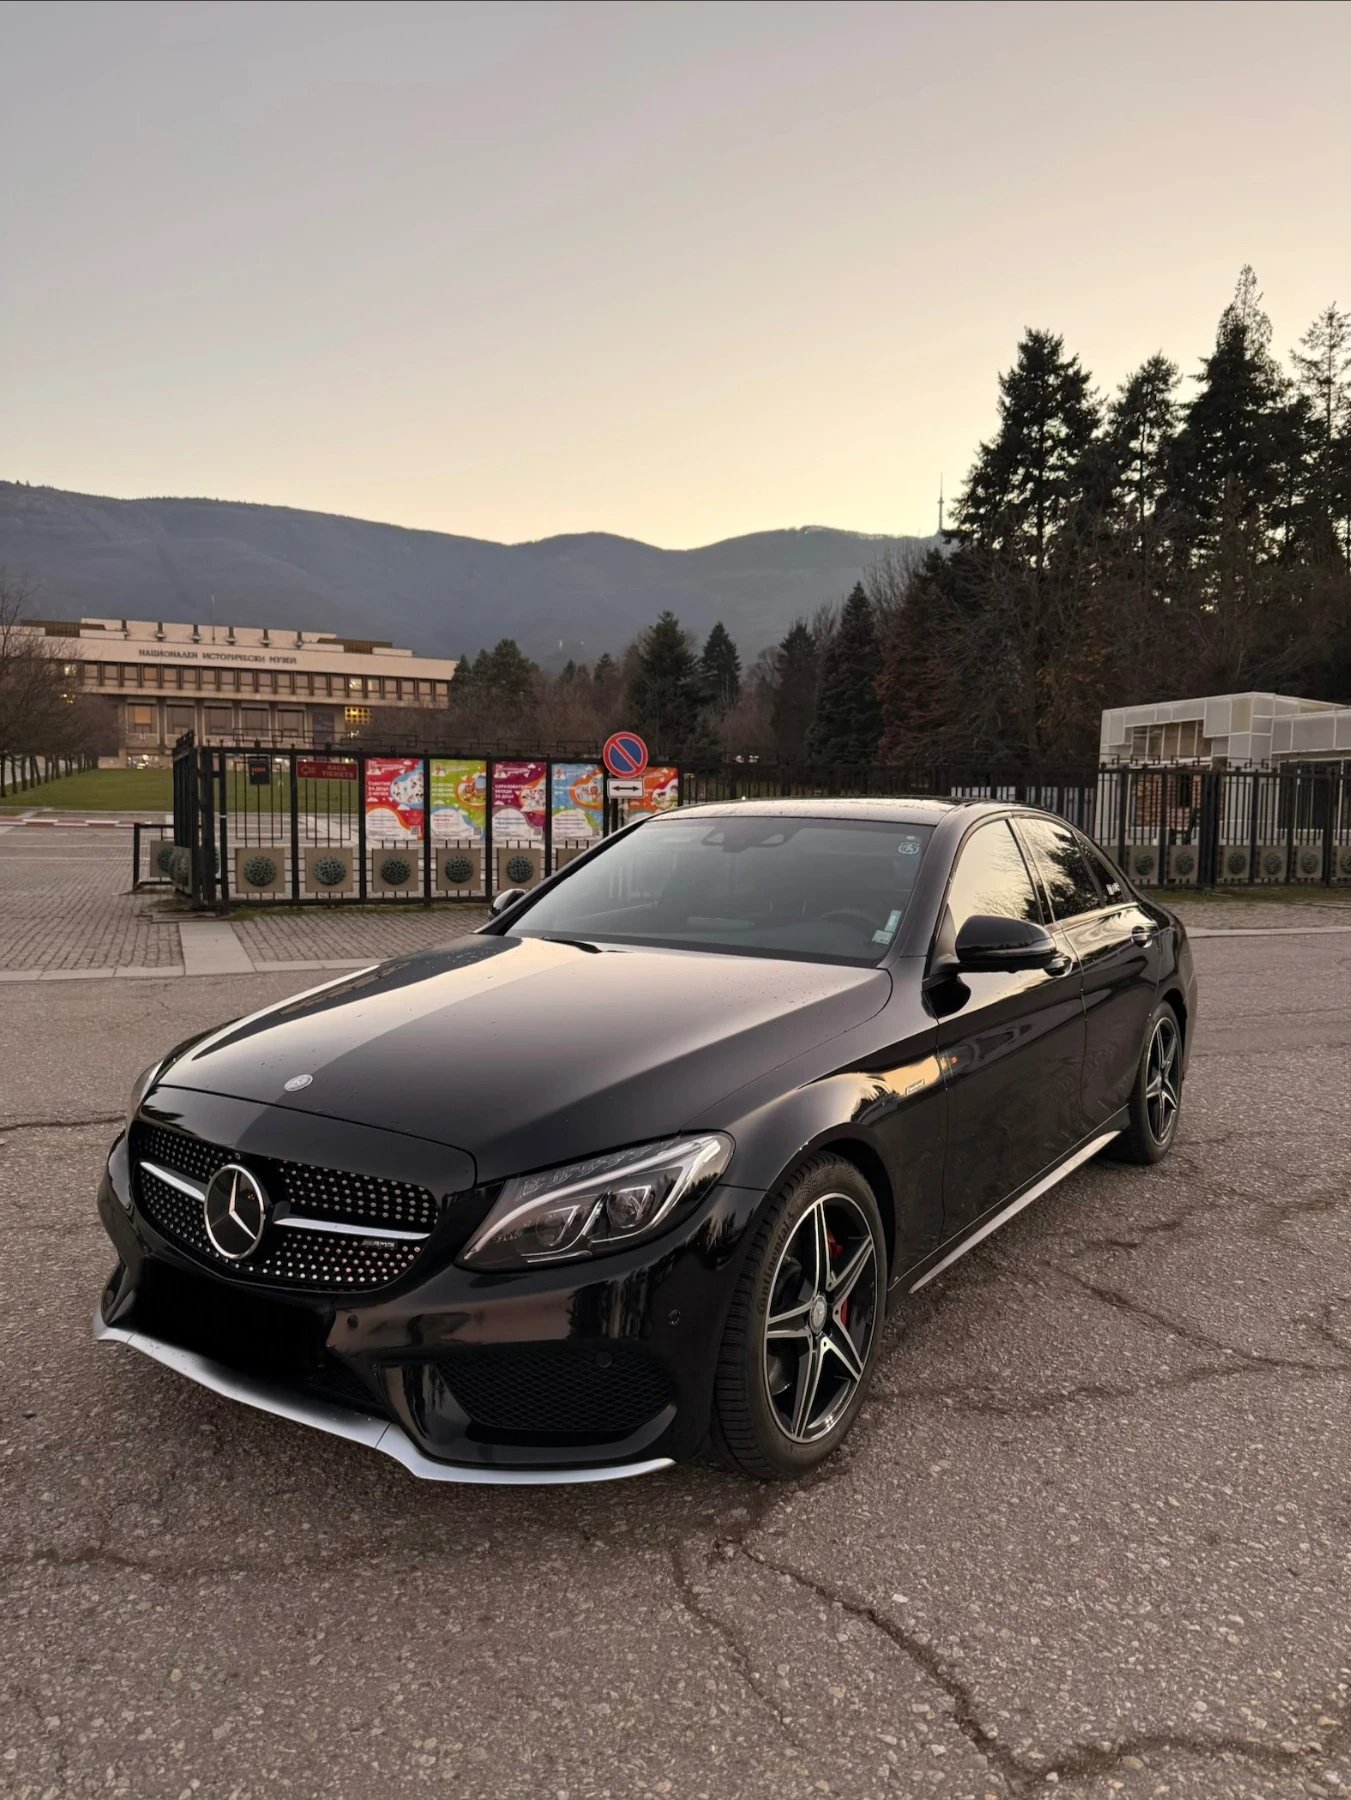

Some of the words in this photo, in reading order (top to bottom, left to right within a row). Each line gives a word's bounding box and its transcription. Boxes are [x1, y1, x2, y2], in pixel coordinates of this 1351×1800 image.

[139, 649, 198, 659] НАЦИОНАЛЕН
[202, 652, 266, 663] ИСТОРИЧЕСКИ
[269, 655, 297, 664] МУЗЕЙ
[321, 770, 354, 778] TICKETS
